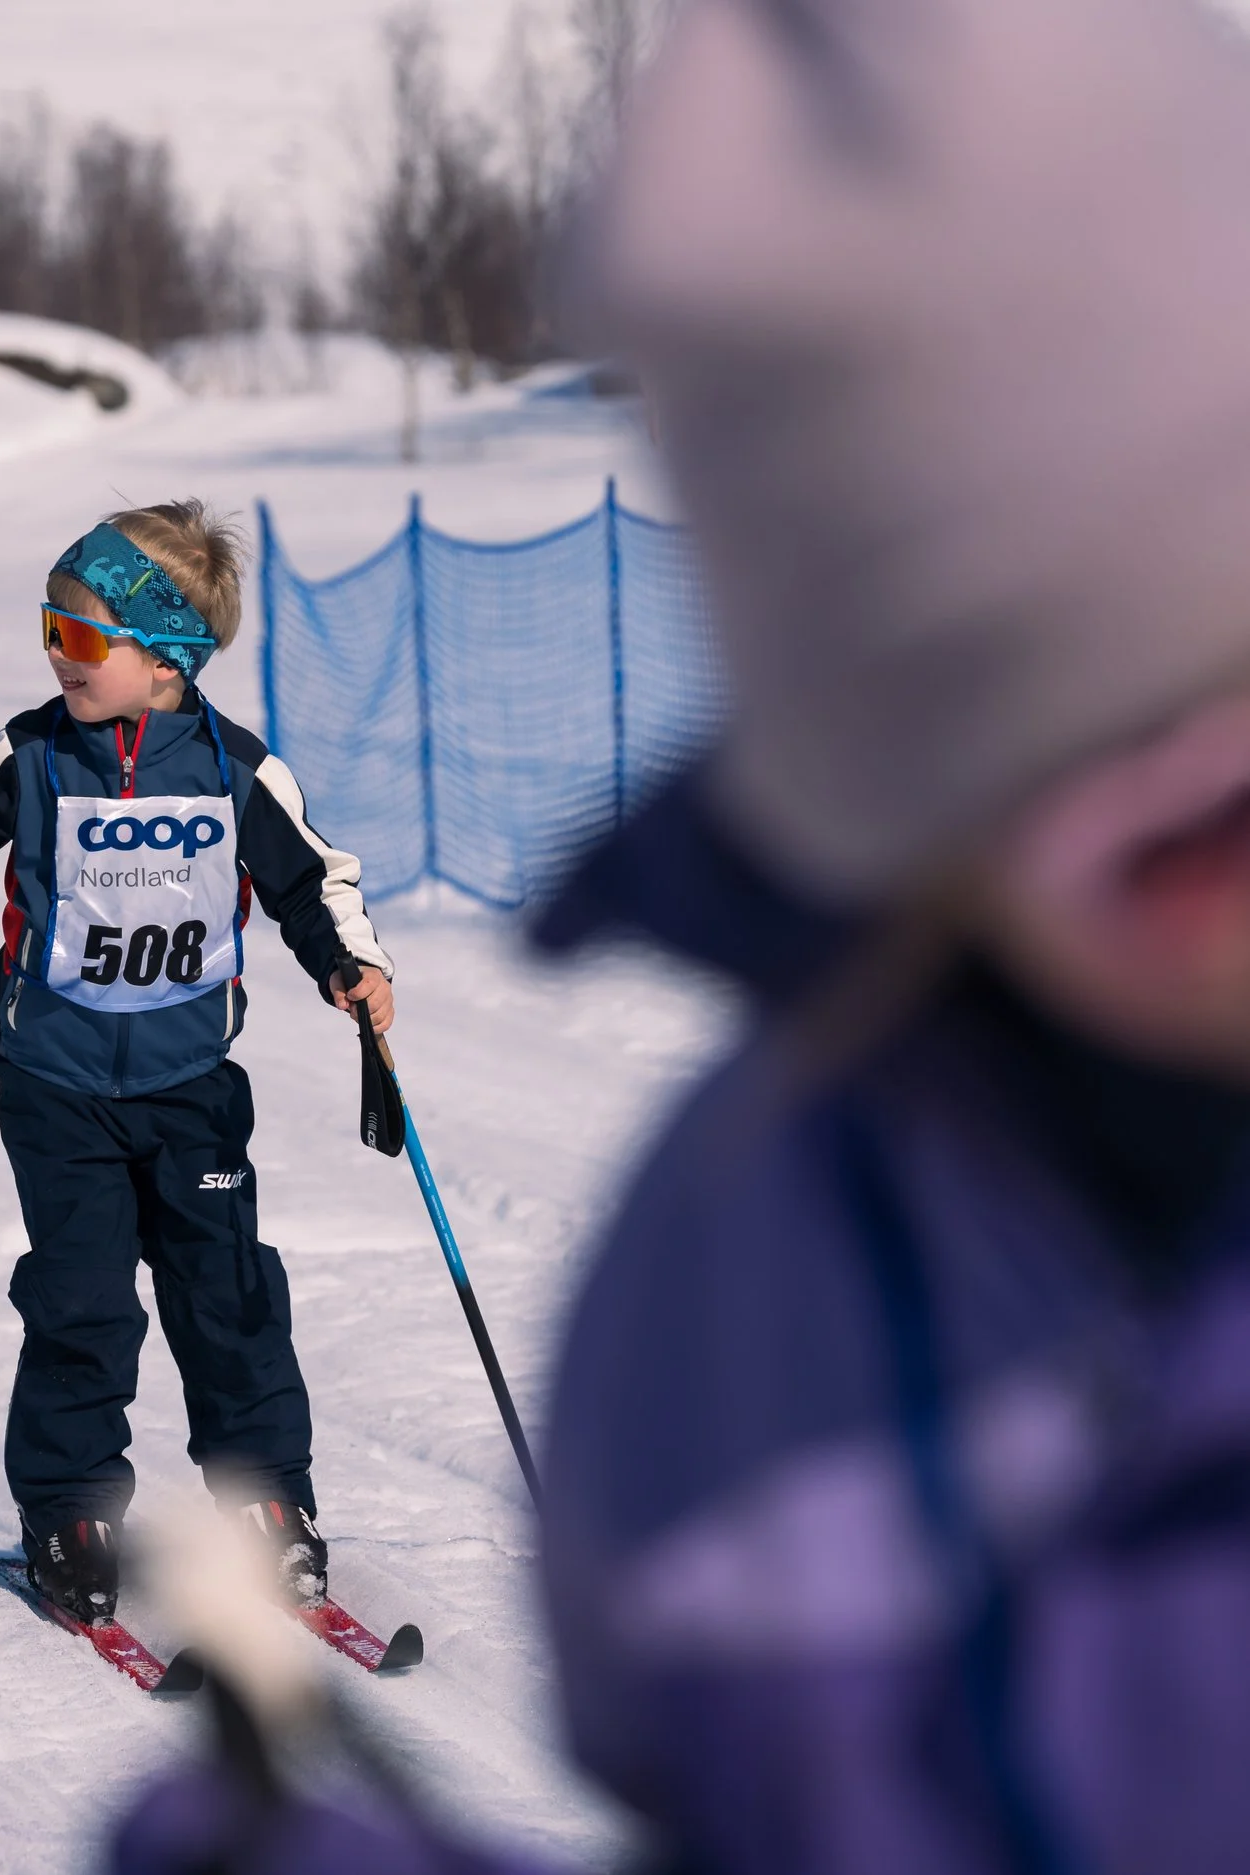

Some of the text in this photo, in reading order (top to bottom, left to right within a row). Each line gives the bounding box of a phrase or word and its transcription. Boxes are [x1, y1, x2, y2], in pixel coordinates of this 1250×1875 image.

[77, 814, 225, 859] coop
[80, 865, 192, 888] Nordland
[80, 919, 208, 987] 508
